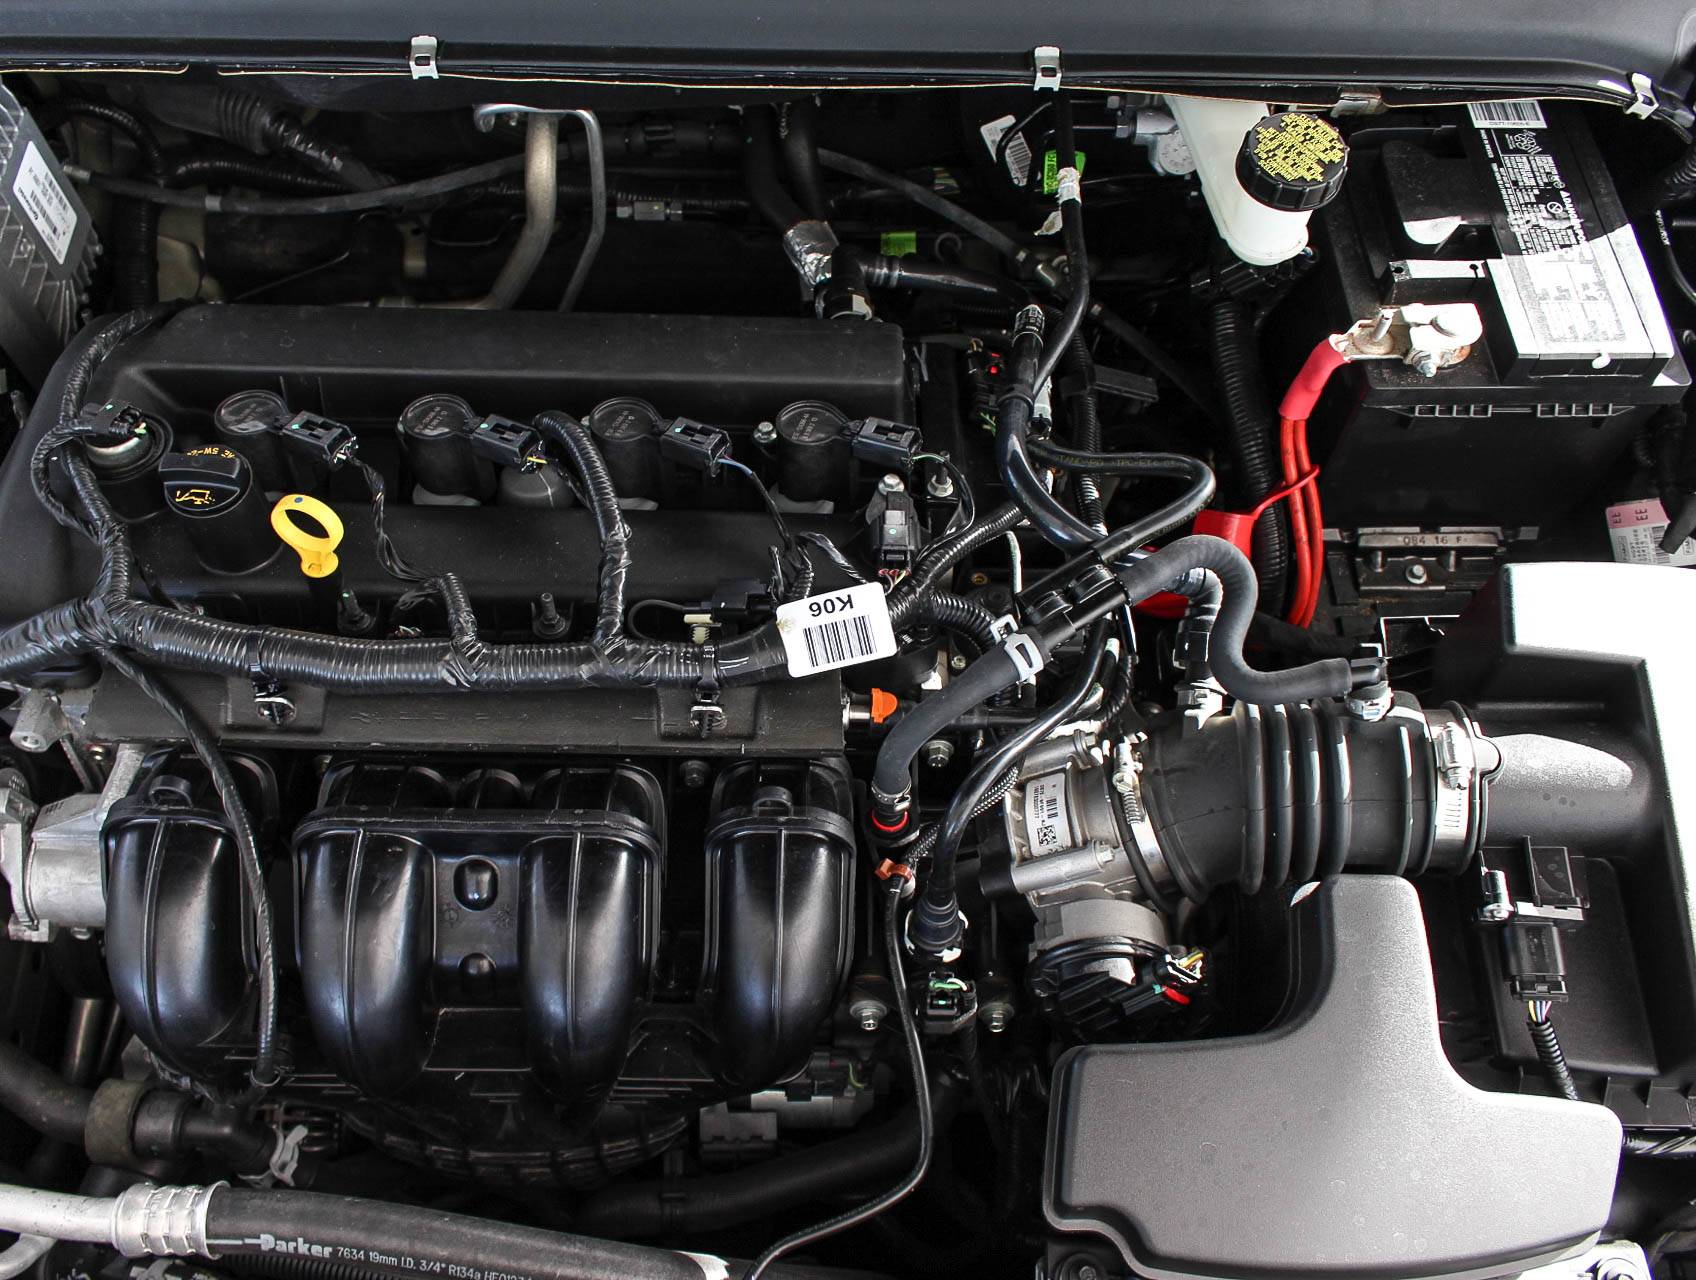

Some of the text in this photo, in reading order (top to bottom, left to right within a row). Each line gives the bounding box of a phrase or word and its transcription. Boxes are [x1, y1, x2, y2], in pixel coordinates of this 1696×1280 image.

[1435, 536, 1449, 545] 16
[808, 594, 854, 618] K06
[259, 1233, 333, 1258] Parker
[337, 1246, 365, 1261] 7634
[369, 1251, 398, 1267] 19mm
[448, 1264, 481, 1280] R134a
